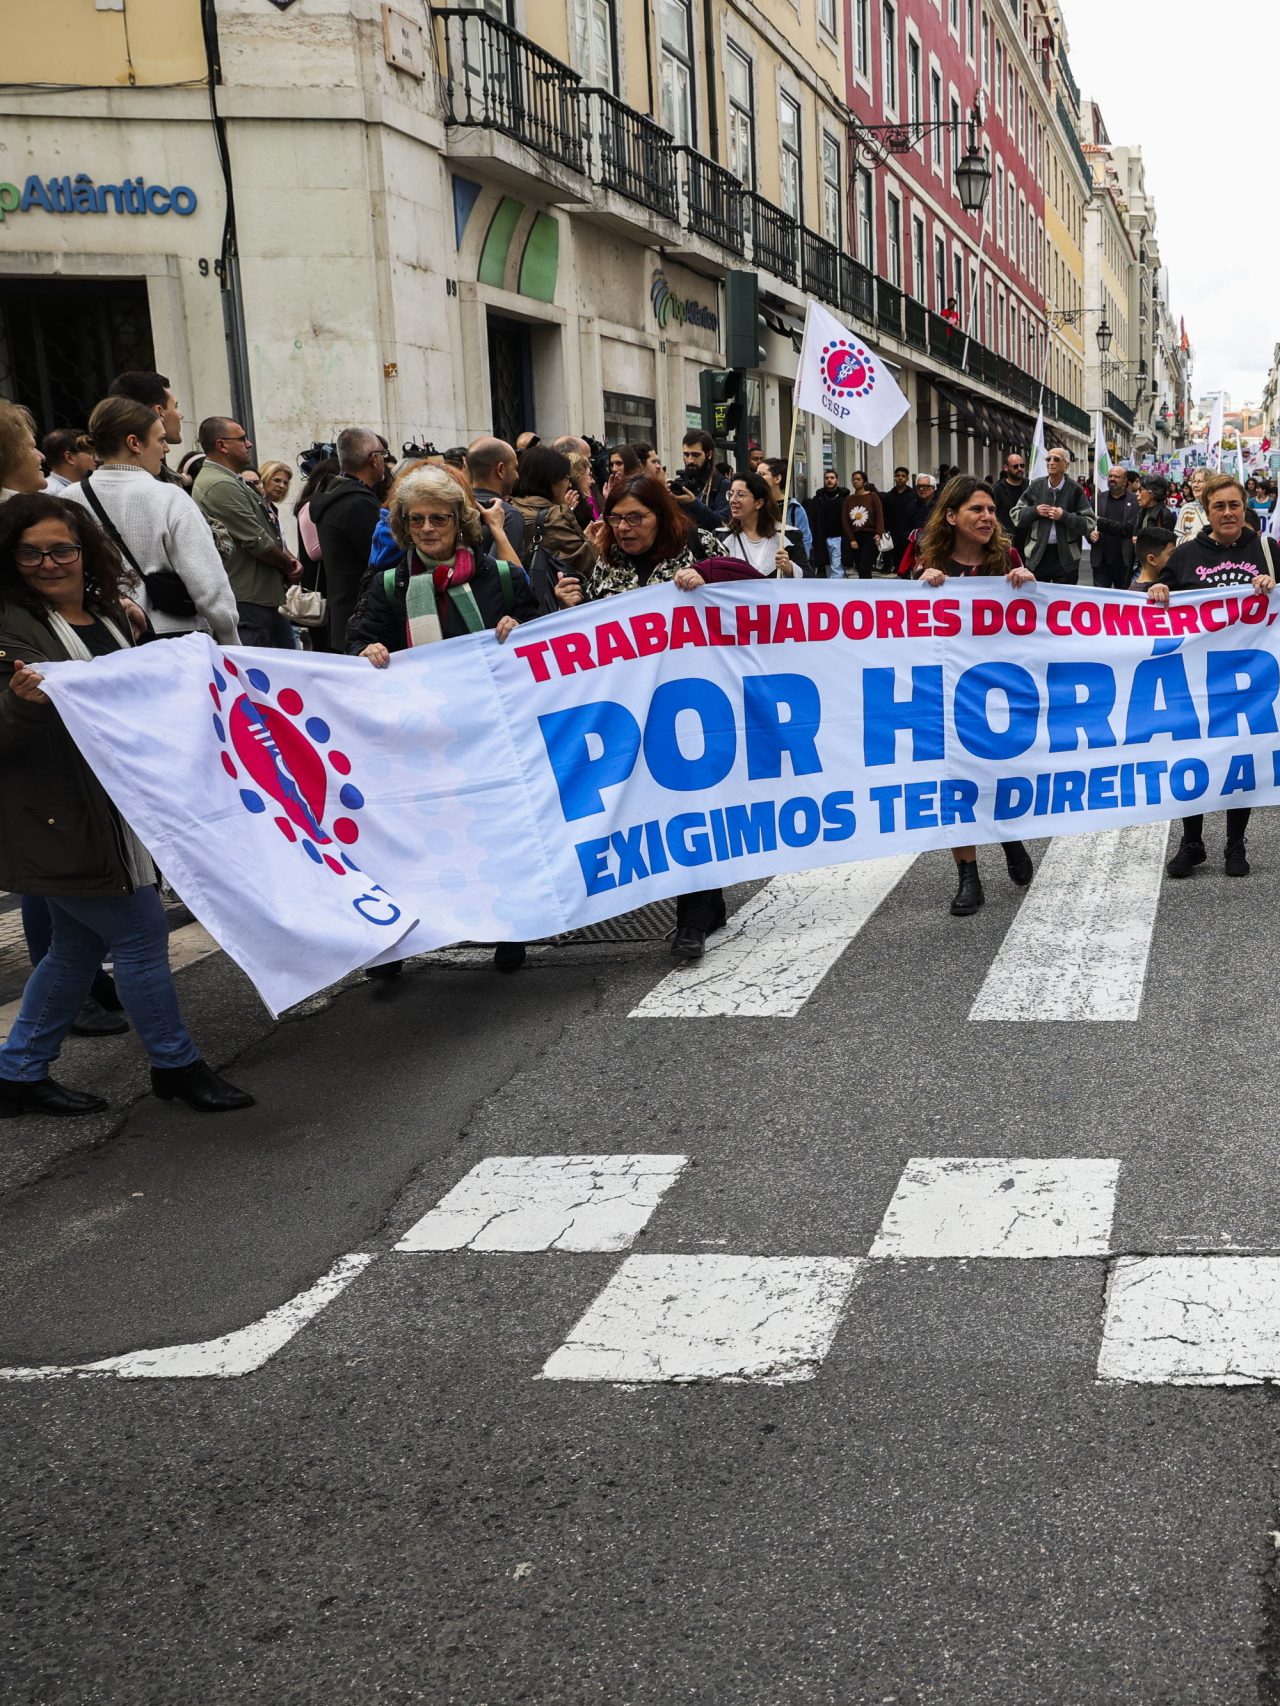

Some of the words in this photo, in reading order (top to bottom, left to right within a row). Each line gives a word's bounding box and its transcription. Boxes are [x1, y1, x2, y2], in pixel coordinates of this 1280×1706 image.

[822, 395, 851, 419] CESP
[1206, 572, 1250, 583] SPORTS
[514, 599, 961, 683] TRABALHADORES
[972, 598, 1037, 636] DO
[1046, 594, 1278, 636] COMÉRCIO,
[537, 673, 823, 822] POR
[575, 790, 856, 898] EXIGIMOS
[869, 779, 979, 834] TER
[994, 757, 1210, 821] DIREITO
[1219, 754, 1256, 796] A
